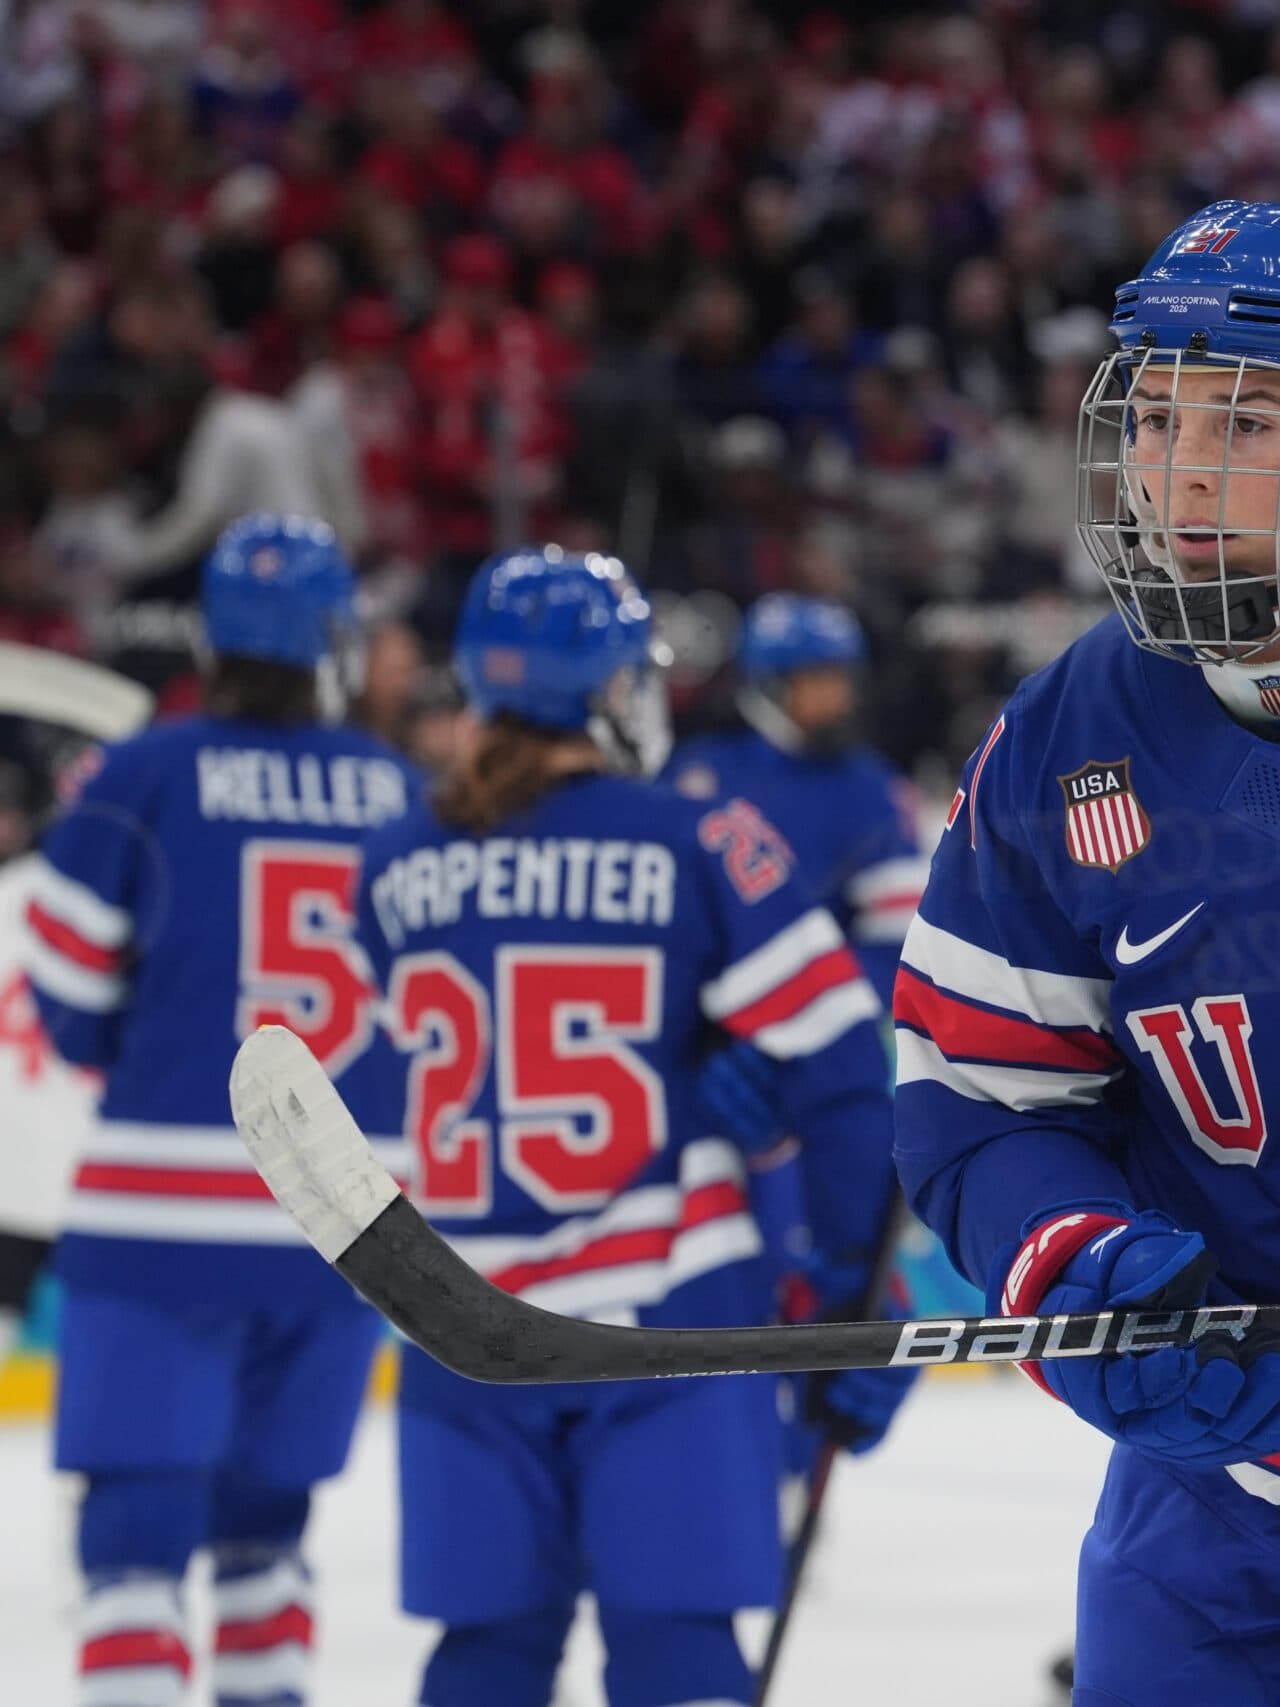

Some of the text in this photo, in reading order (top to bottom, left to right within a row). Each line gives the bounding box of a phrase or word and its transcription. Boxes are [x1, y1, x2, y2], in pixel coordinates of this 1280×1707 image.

[1176, 228, 1240, 254] 21
[1143, 296, 1220, 306] MILANO CORTINA
[1169, 304, 1188, 313] 2026
[1071, 771, 1120, 799] USA
[239, 842, 376, 1079] 5
[390, 945, 668, 1217] 25
